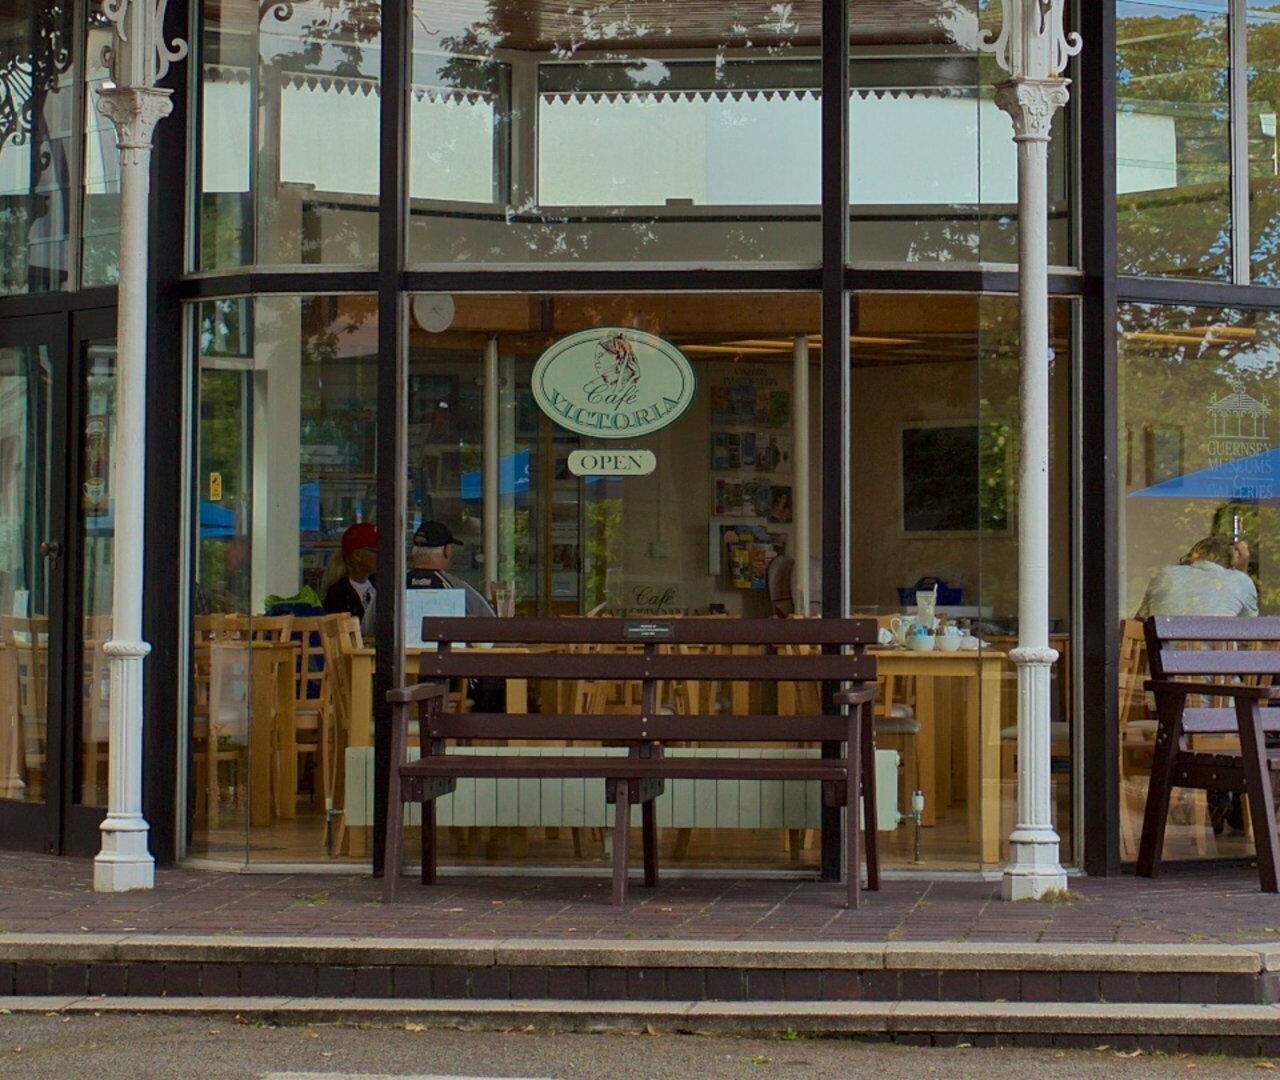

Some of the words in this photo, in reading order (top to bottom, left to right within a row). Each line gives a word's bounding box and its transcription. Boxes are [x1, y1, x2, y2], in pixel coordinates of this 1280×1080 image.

[583, 381, 640, 411] Café
[547, 388, 681, 430] VICTORIA
[1207, 440, 1272, 457] GUERNSEY
[581, 455, 642, 469] OPEN
[1207, 457, 1272, 474] MUSEUMS
[1207, 484, 1273, 499] GALLERIES
